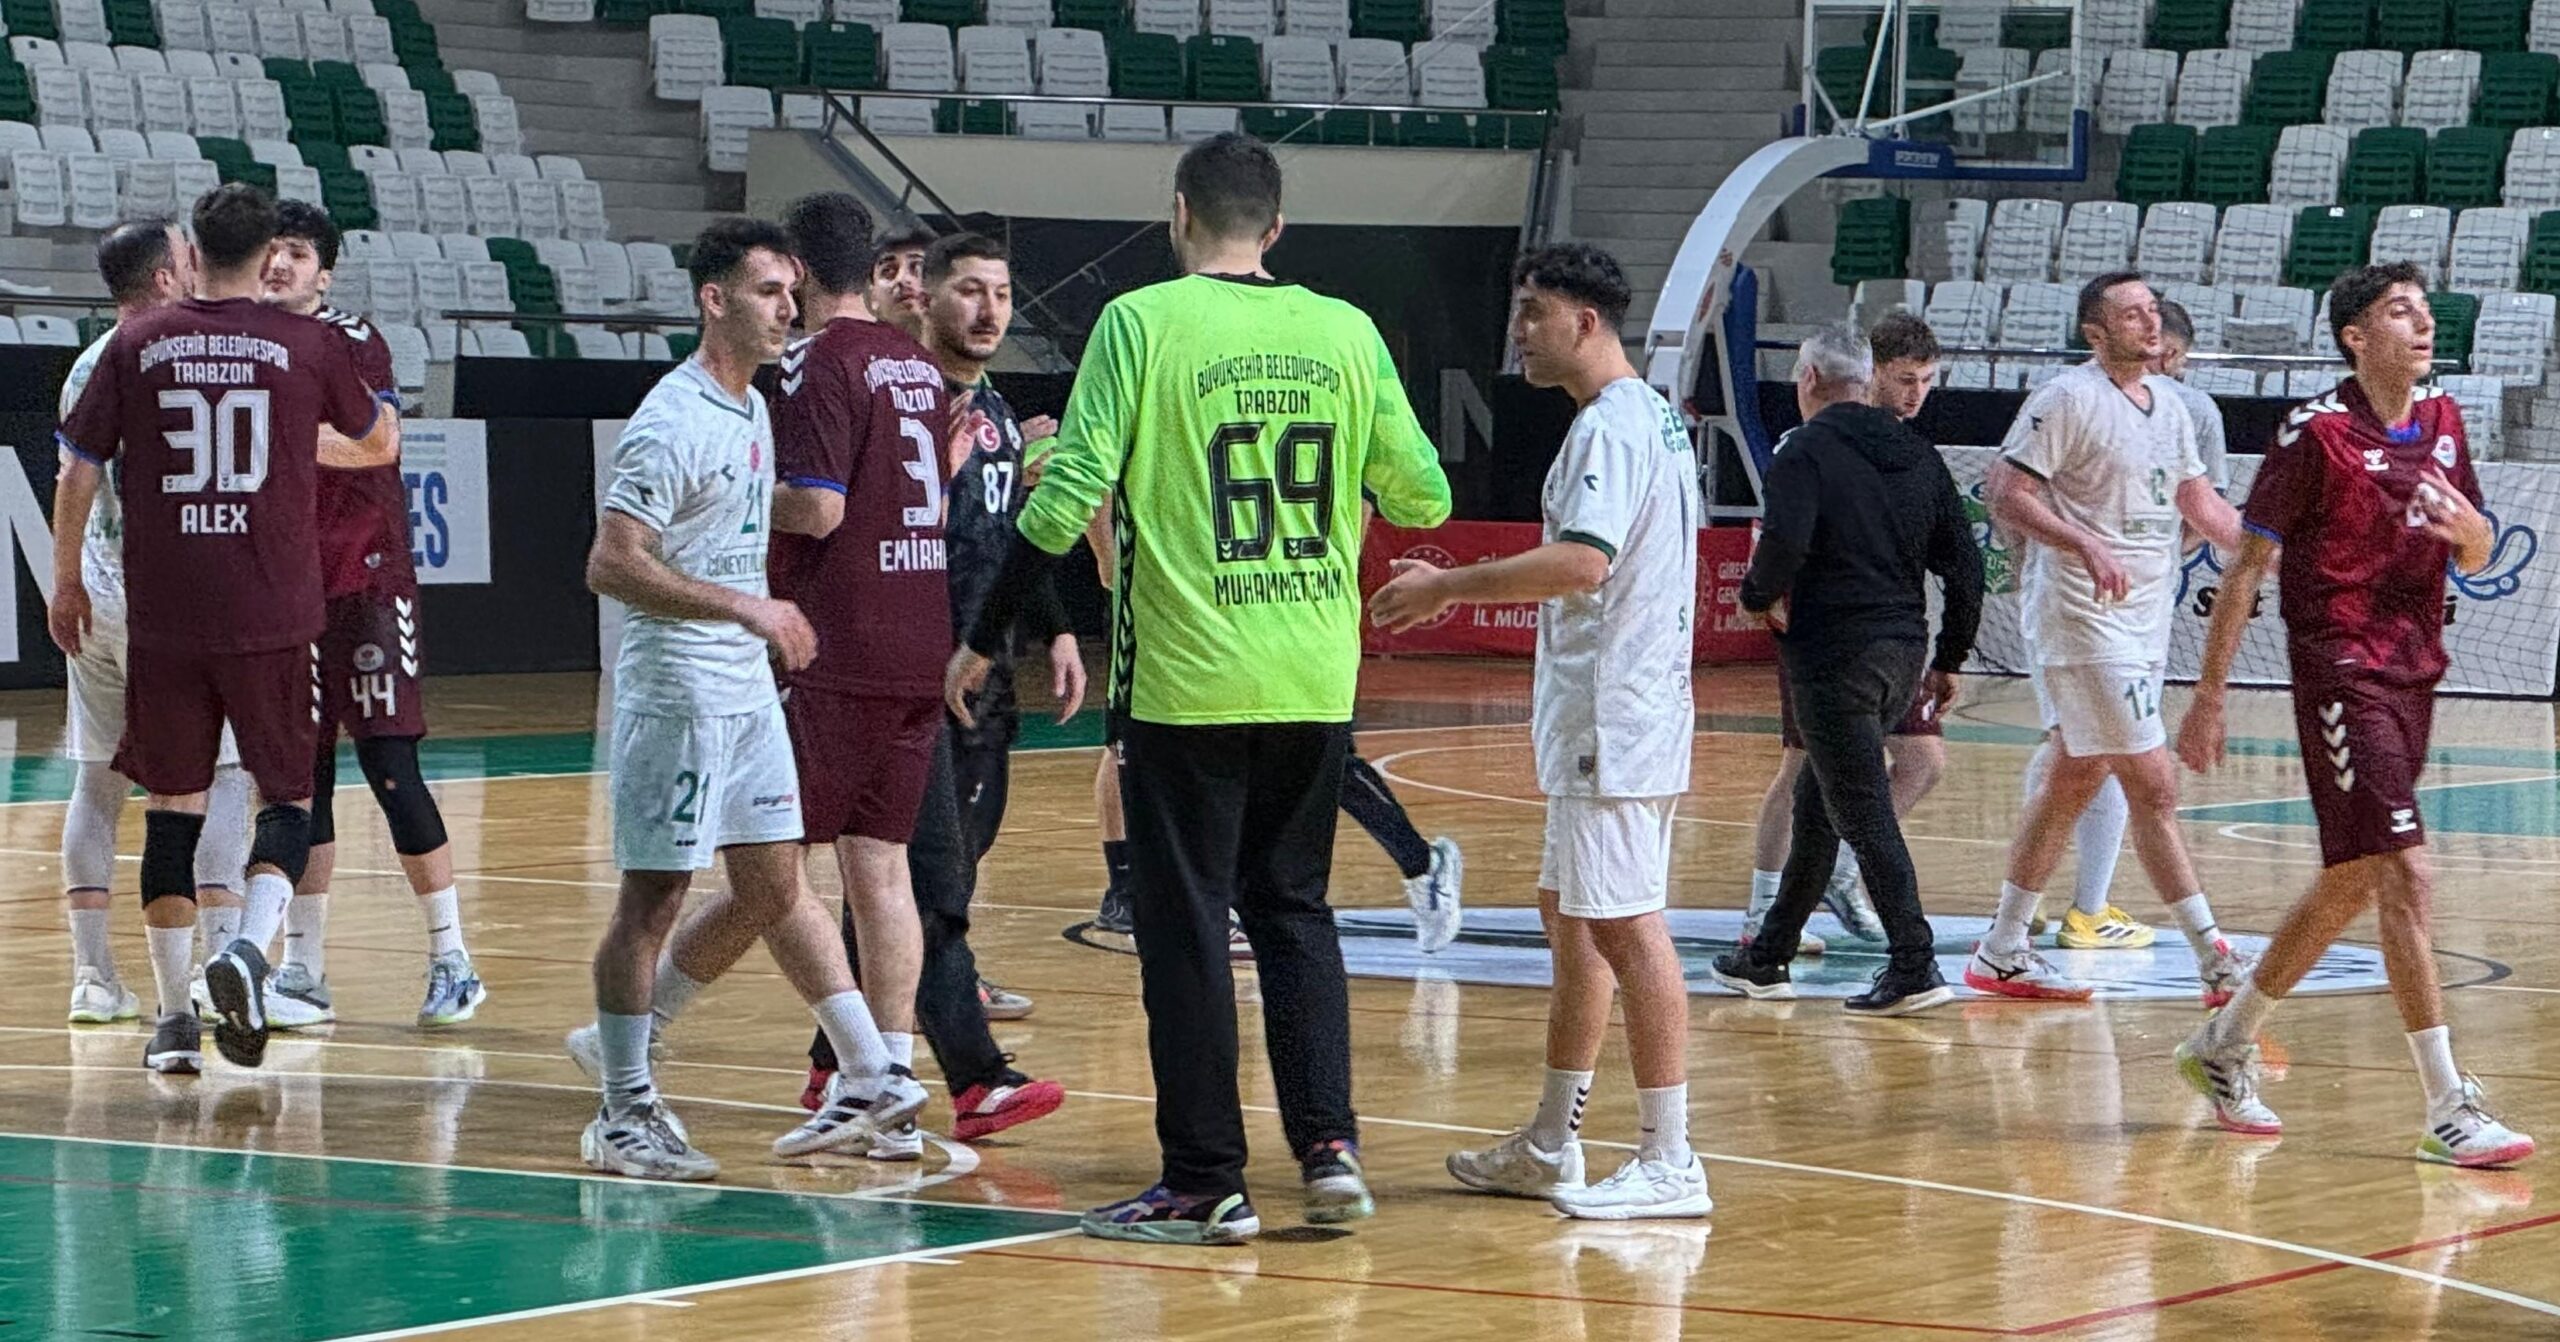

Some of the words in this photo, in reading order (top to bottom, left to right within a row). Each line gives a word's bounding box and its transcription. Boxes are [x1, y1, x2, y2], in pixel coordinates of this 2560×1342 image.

[172, 361, 256, 384] TRABZON
[1197, 347, 1263, 399] BÜYÜKŞEHİR
[1234, 389, 1310, 414] TRABZON
[158, 390, 270, 493] 30
[900, 417, 942, 526] 3
[982, 461, 1014, 514] 87
[1207, 422, 1336, 562] 69
[181, 504, 248, 534] ALEX
[741, 479, 764, 534] 21
[879, 532, 948, 571] EMİRH
[350, 673, 396, 718] 44
[2124, 679, 2156, 721] 12
[672, 771, 711, 825] 21
